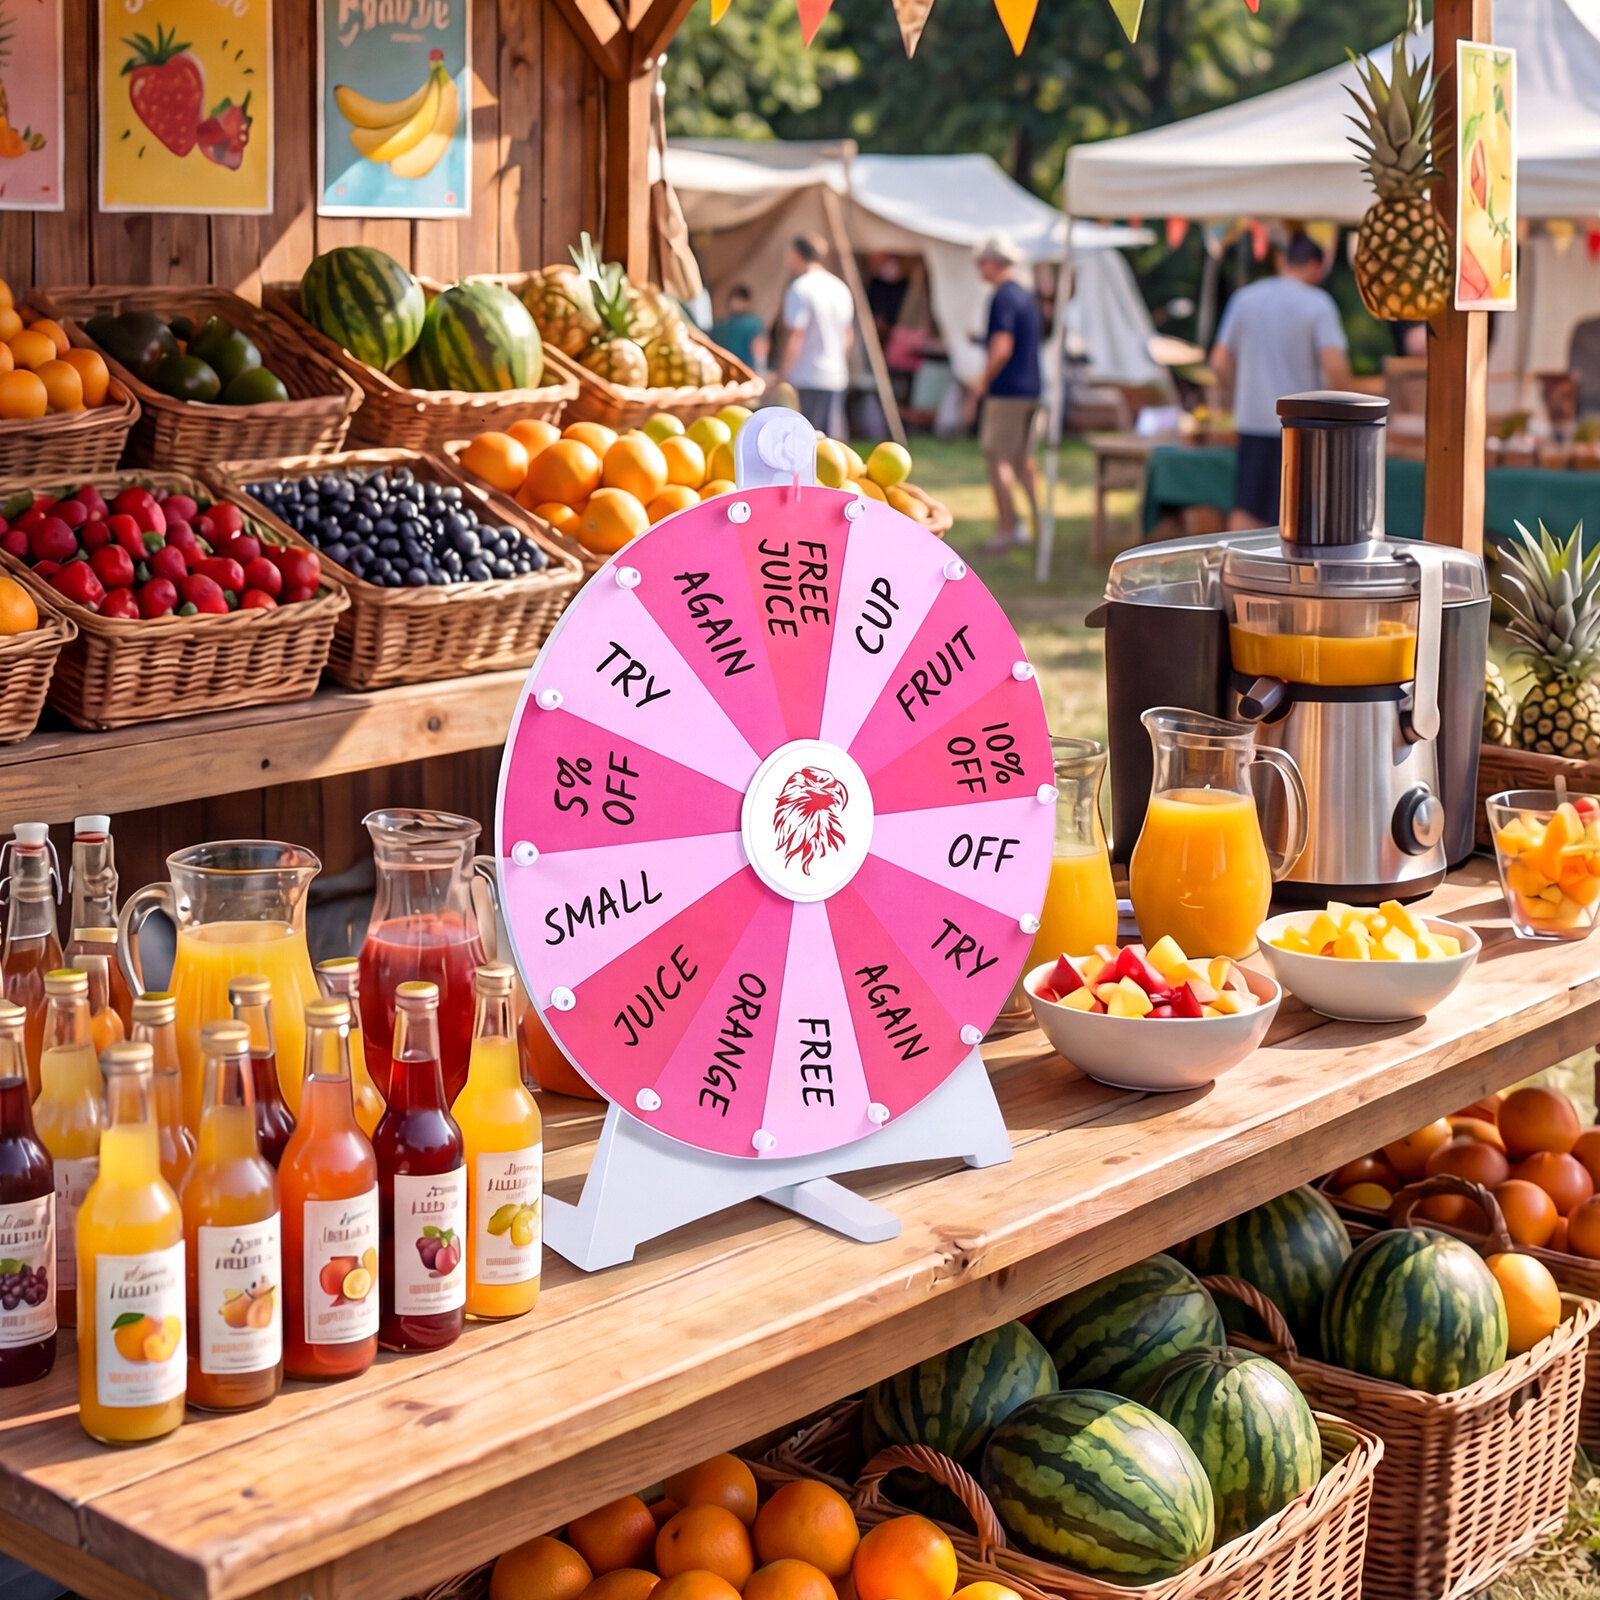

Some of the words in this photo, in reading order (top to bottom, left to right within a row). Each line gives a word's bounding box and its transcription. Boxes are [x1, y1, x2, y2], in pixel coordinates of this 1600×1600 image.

[758, 538, 797, 638] JUICE
[798, 540, 830, 626] FREE
[855, 577, 900, 655] CUP
[673, 571, 756, 677] AGAIN
[595, 641, 672, 708] TRY
[896, 625, 976, 721] FRUIT
[553, 756, 593, 817] 5%
[601, 750, 640, 826] OFF
[947, 736, 986, 794] OFF
[981, 722, 1025, 786] 10%
[948, 833, 1021, 873] OFF
[544, 870, 663, 946] SMALL
[931, 918, 998, 979] TRY
[613, 944, 698, 1046] JUICE
[855, 964, 930, 1061] AGAIN
[699, 972, 767, 1118] ORANGE
[798, 1018, 835, 1107] FREE
